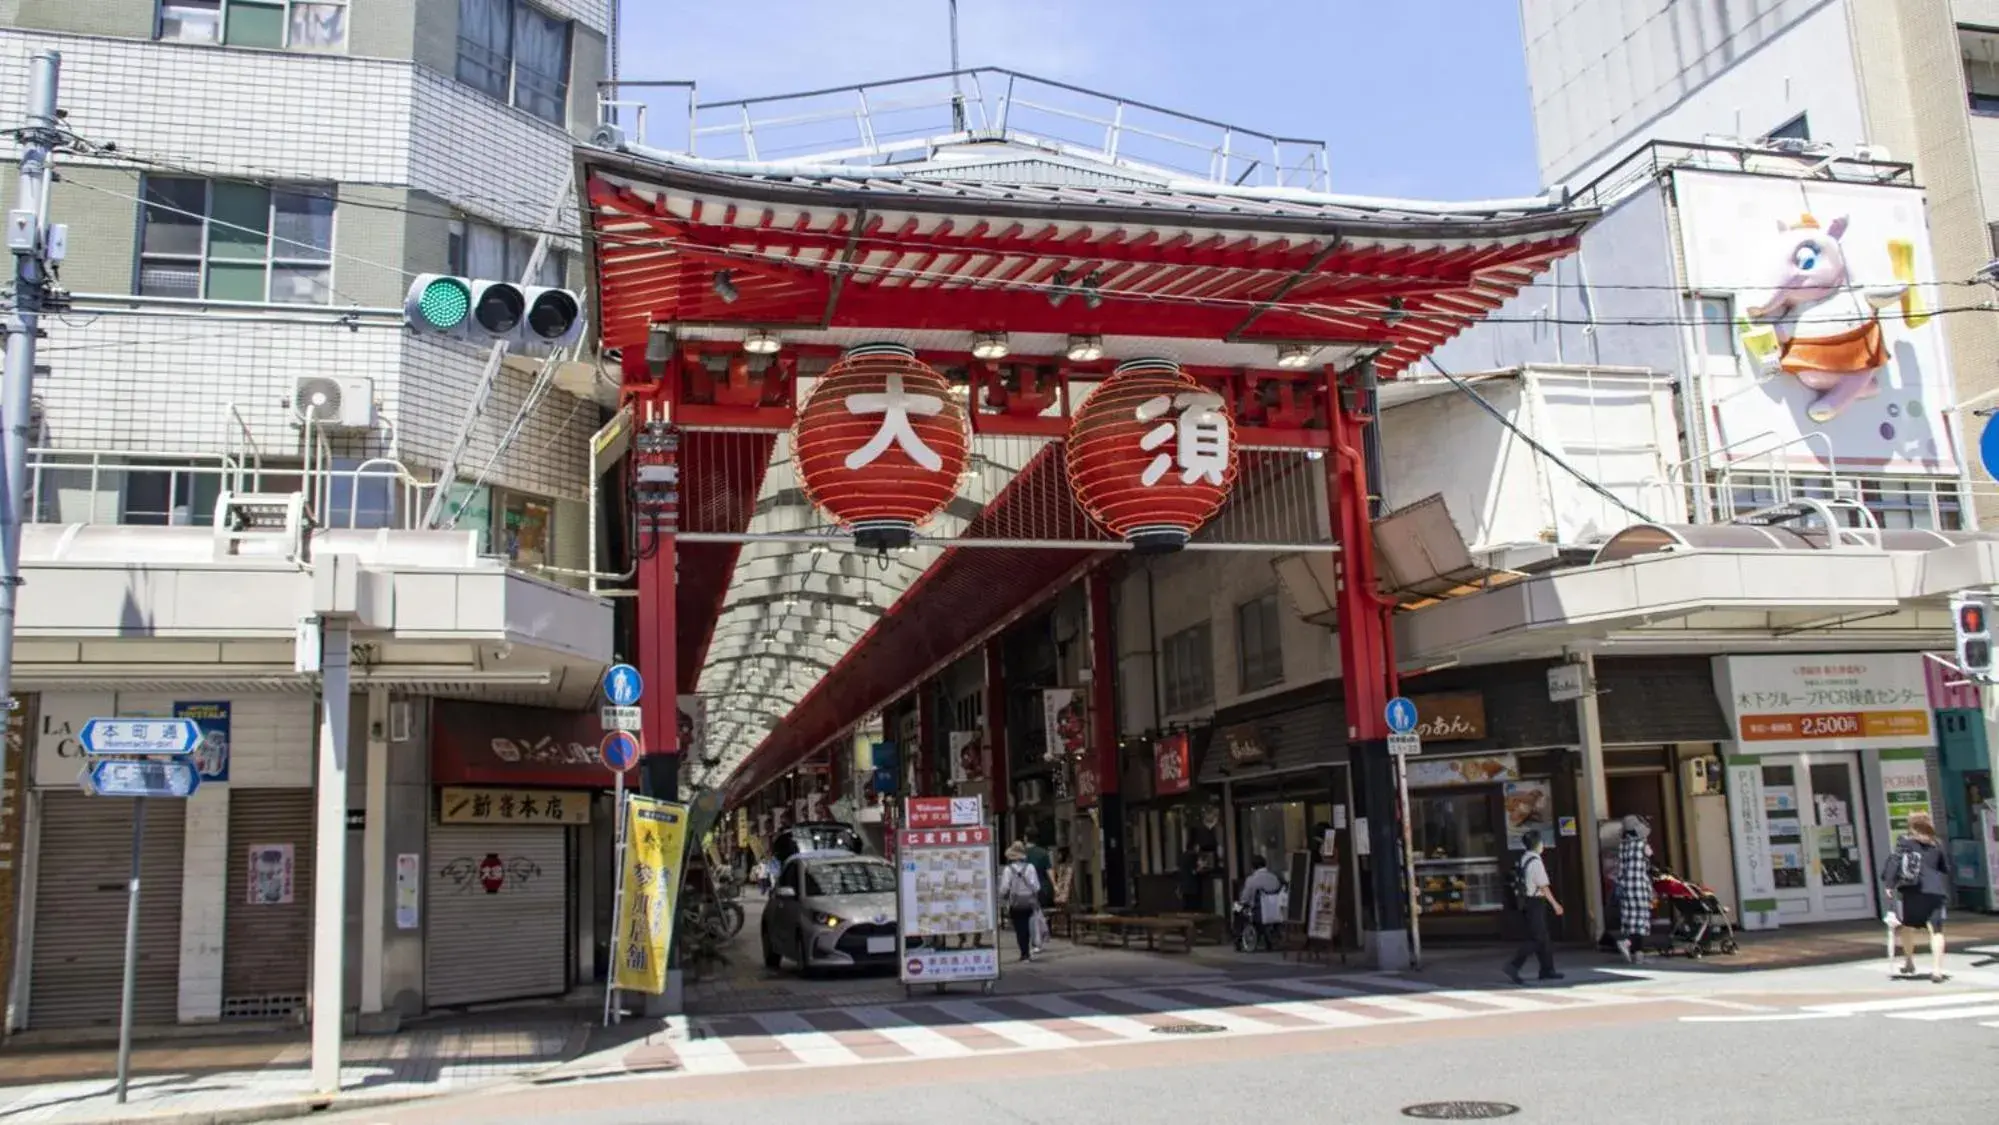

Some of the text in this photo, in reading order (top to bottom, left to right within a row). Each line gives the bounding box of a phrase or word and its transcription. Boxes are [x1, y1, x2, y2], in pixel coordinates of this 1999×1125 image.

[843, 374, 944, 471] 大
[1134, 393, 1228, 487] 須
[43, 715, 71, 735] LA
[102, 724, 178, 740] 本町通
[1412, 715, 1476, 736] のあん。
[1801, 716, 1857, 735] 2,500円
